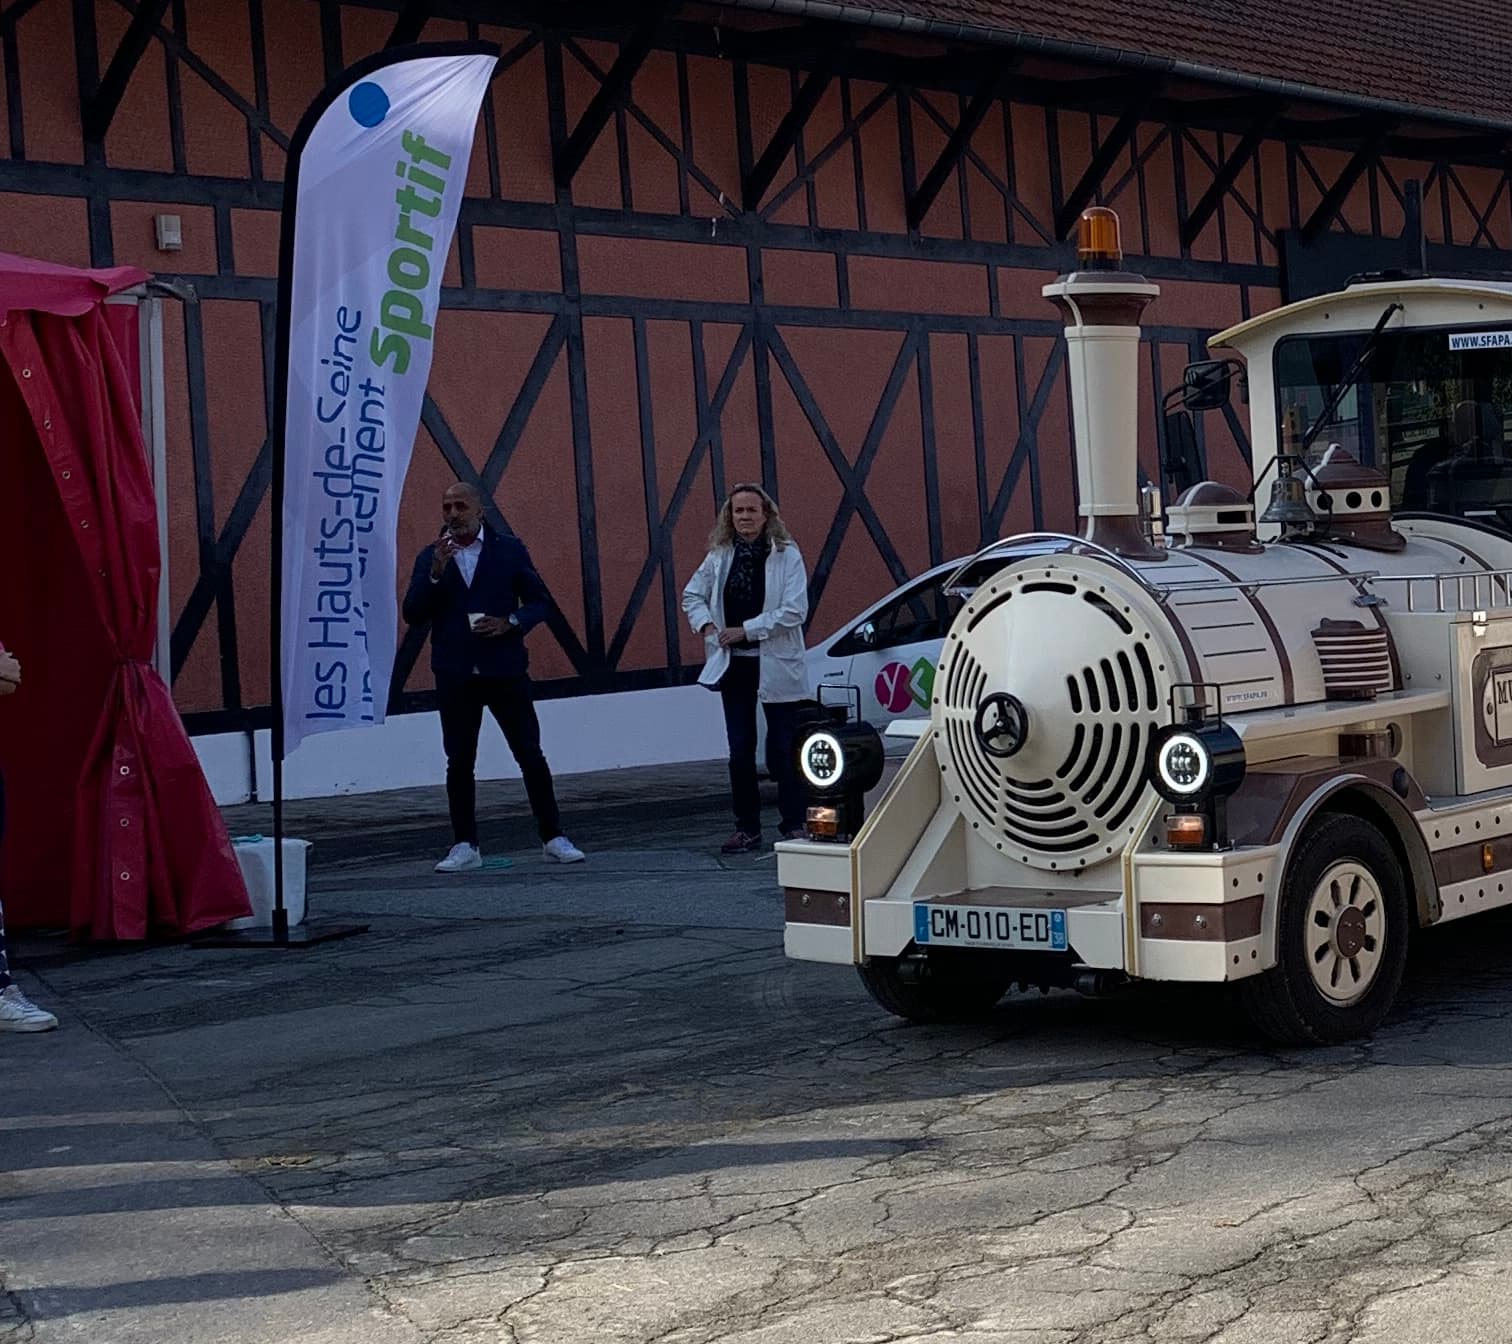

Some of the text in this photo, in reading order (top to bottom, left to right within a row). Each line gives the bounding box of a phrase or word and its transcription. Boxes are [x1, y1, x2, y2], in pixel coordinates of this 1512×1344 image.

[370, 129, 451, 375] sportif
[305, 306, 361, 720] les Hauts-de-Seine
[931, 909, 1050, 942] CM-010-ED
